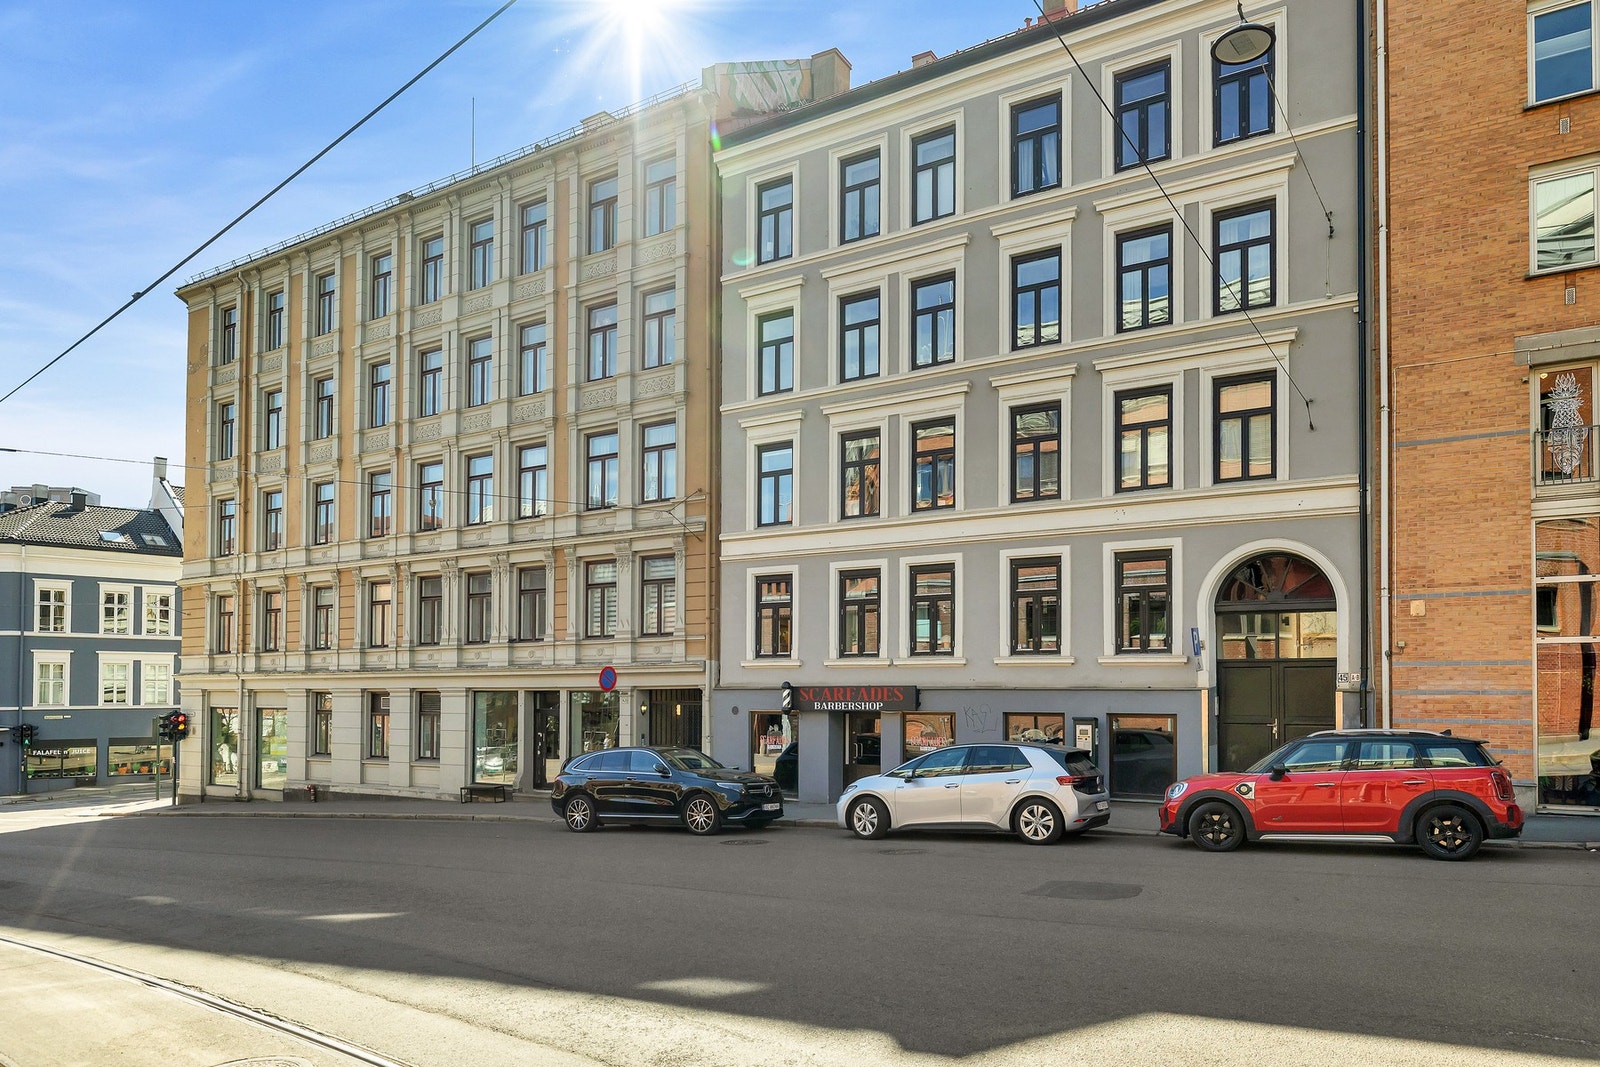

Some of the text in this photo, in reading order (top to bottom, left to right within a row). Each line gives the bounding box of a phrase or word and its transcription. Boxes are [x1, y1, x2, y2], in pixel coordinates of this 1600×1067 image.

[1338, 674, 1348, 682] 45
[799, 687, 905, 702] SCARFADES
[814, 701, 884, 711] BARBERSHOP
